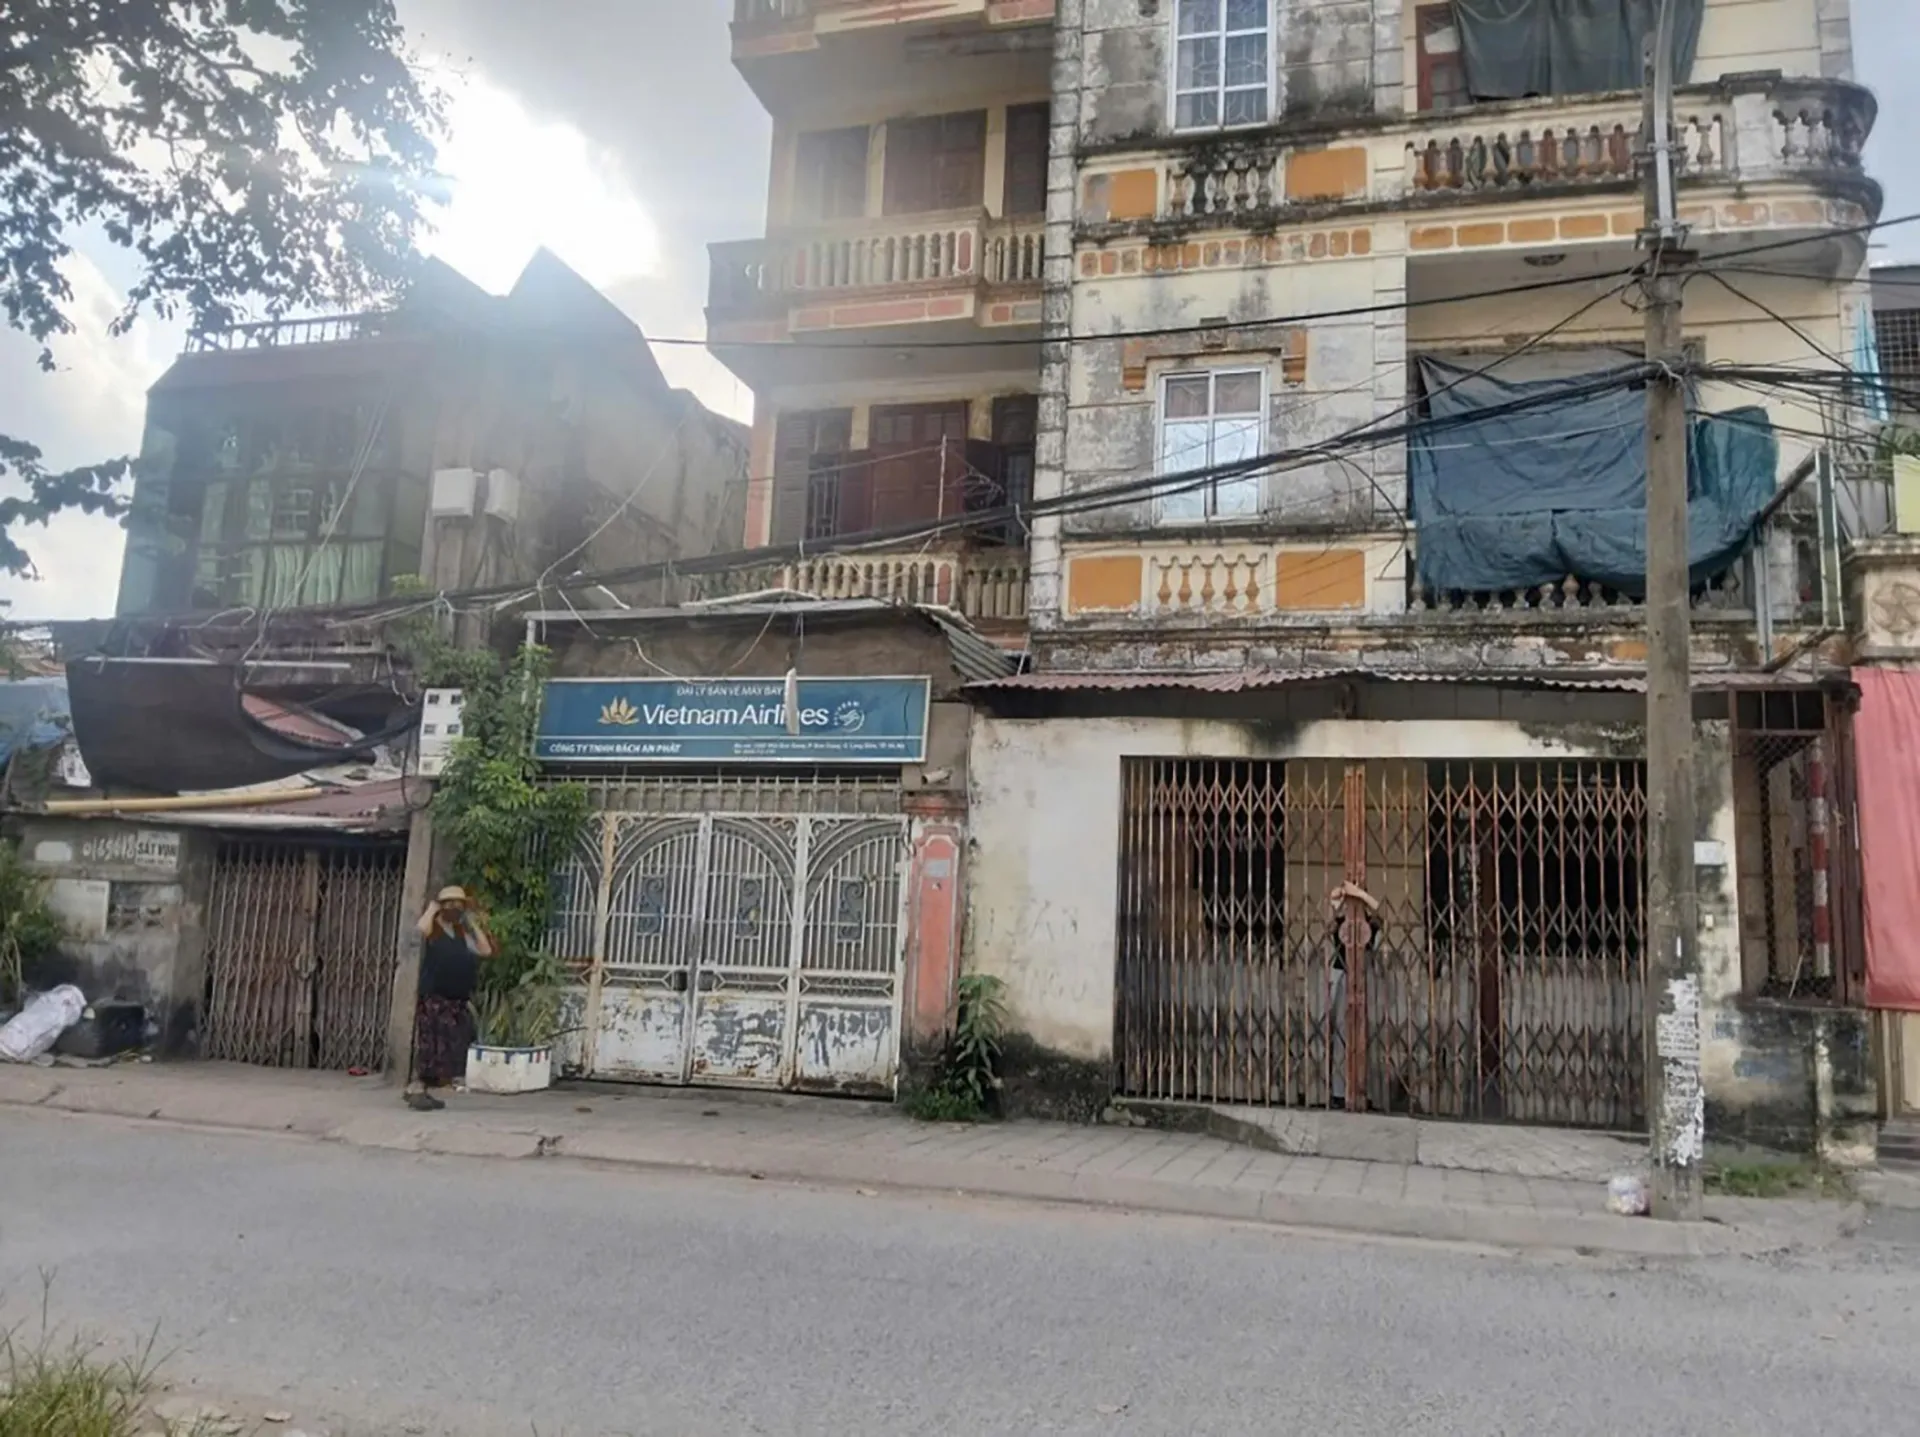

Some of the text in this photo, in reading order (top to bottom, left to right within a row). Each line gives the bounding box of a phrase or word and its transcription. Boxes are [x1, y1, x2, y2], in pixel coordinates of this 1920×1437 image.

[643, 704, 739, 725] Vietnam
[739, 705, 830, 726] Airlies
[576, 743, 589, 754] TY
[641, 743, 656, 754] AN
